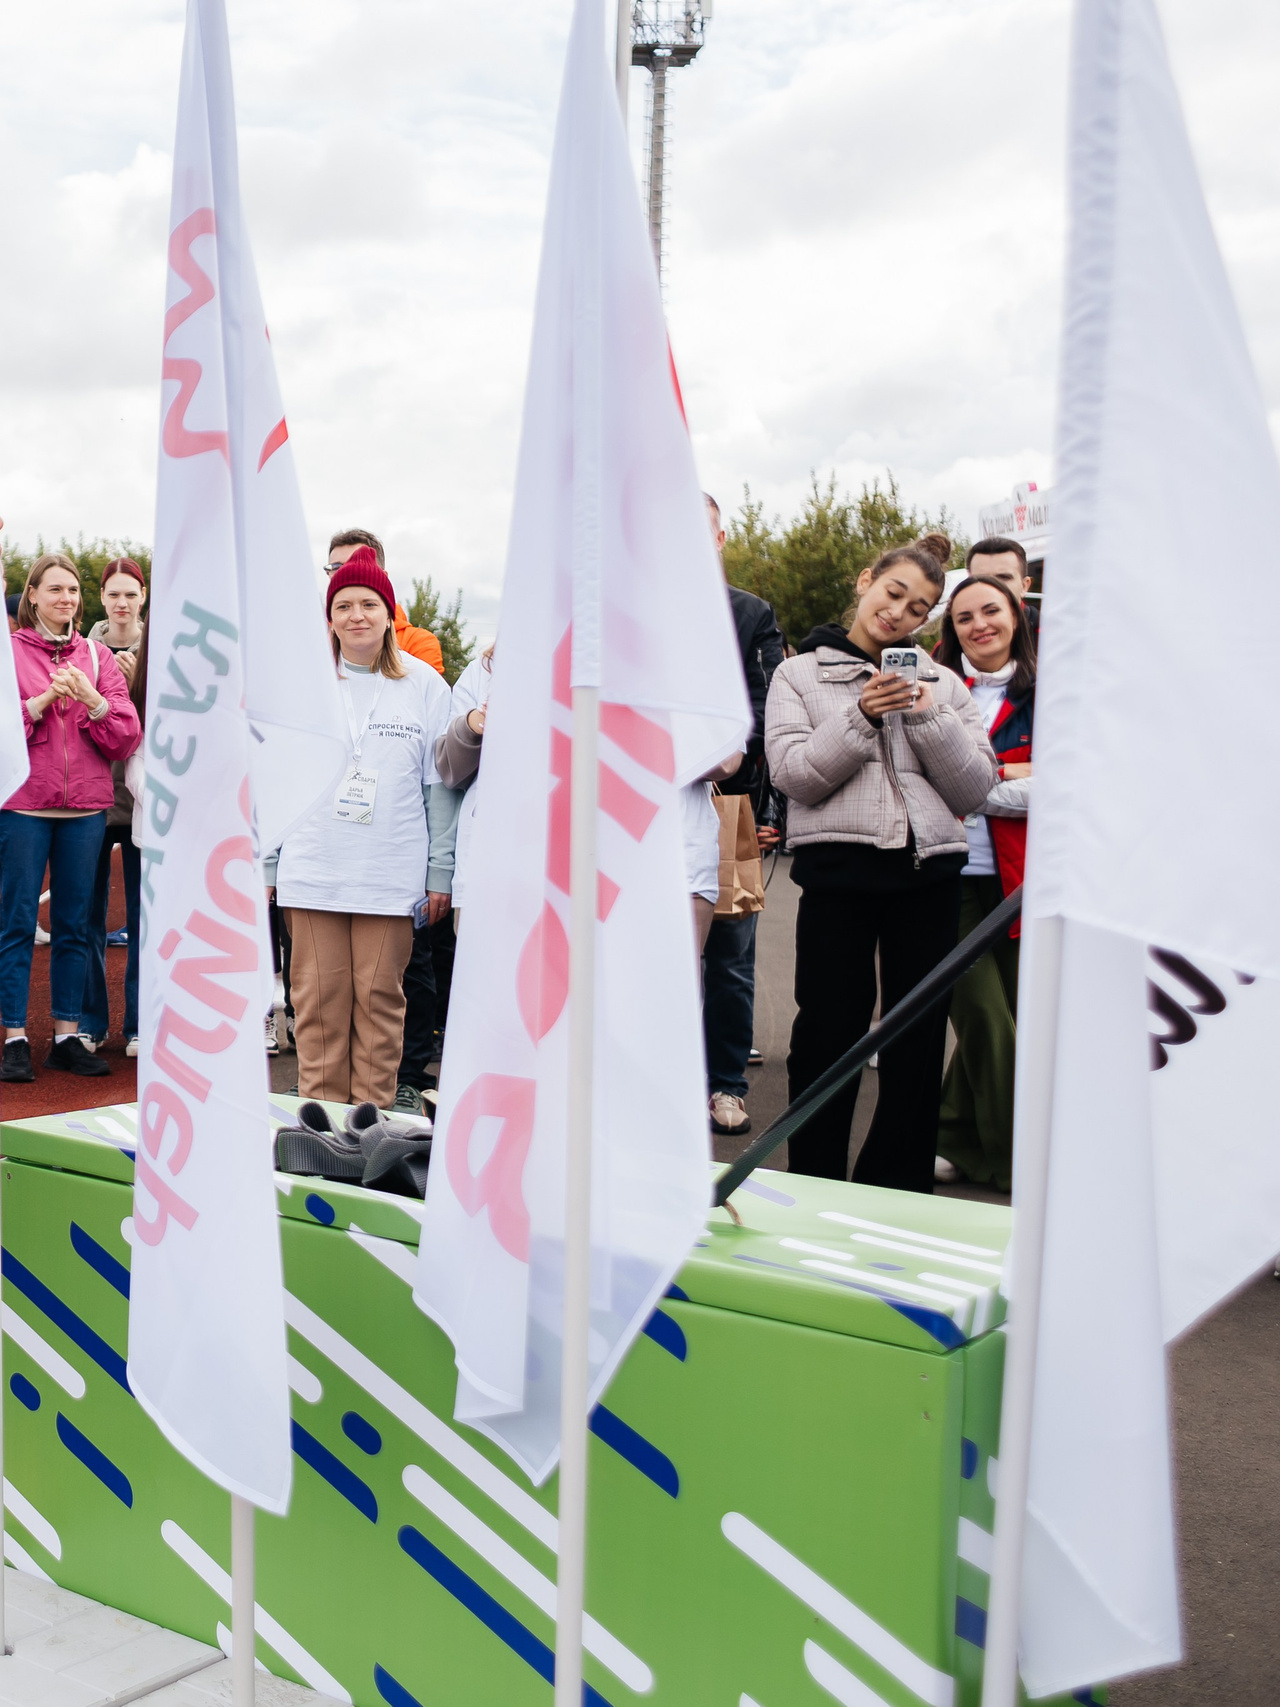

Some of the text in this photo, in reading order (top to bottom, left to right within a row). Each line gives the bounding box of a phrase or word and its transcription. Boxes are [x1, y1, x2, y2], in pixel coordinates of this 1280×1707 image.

[368, 723, 421, 735] СПРОСИТЕ МЕНЯ
[385, 731, 413, 740] ПОМОГУ
